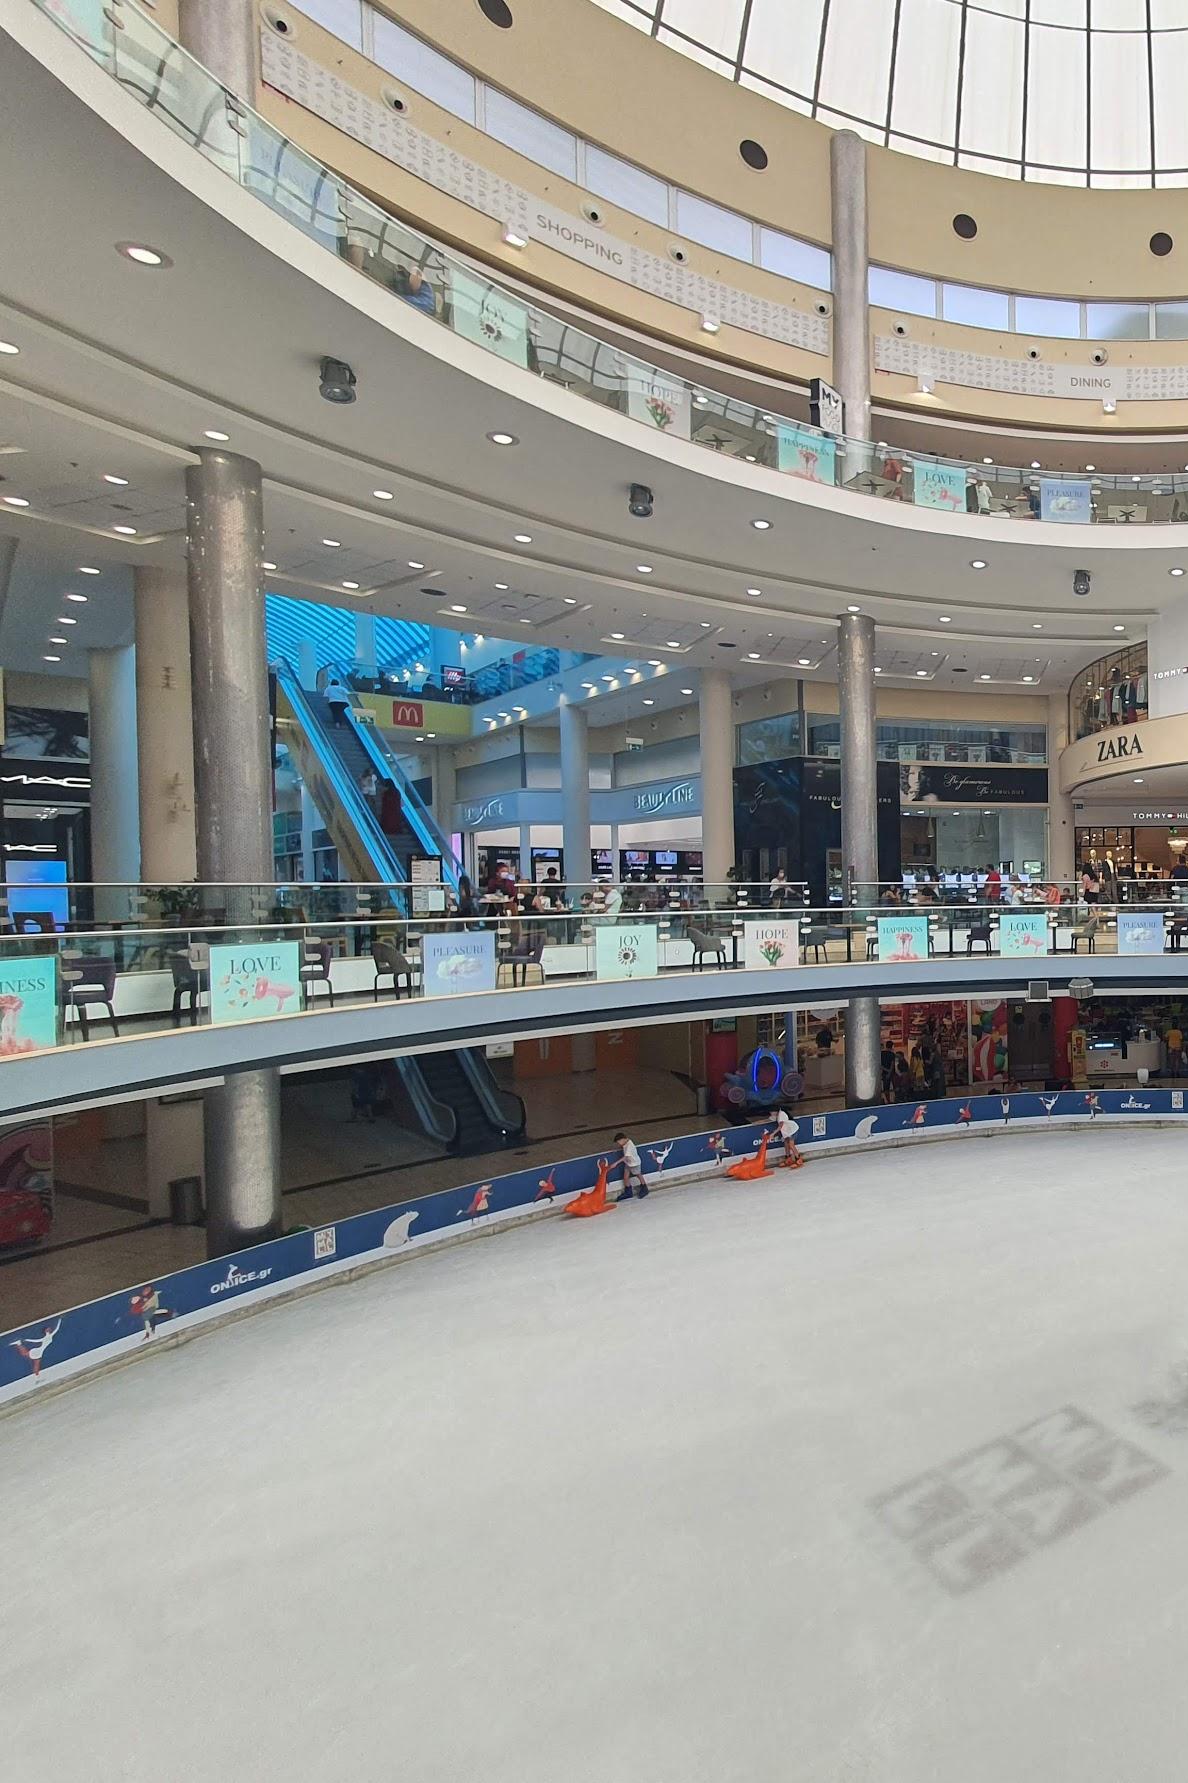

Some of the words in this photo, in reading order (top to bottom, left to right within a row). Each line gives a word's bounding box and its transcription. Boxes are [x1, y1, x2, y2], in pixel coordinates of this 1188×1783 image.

[537, 214, 623, 265] SHOPPING
[1070, 377, 1112, 388] DINING
[925, 471, 956, 486] LOVE
[1047, 488, 1084, 498] PLEASURE
[1153, 668, 1181, 680] TOMMY
[1097, 733, 1143, 762] ZARA
[882, 925, 923, 934] HAPPINESS
[1009, 922, 1038, 932] LOVE
[618, 934, 641, 948] JOY
[755, 928, 789, 941] HOPE
[432, 944, 485, 957] PLEASURE
[229, 955, 282, 976] LOVE
